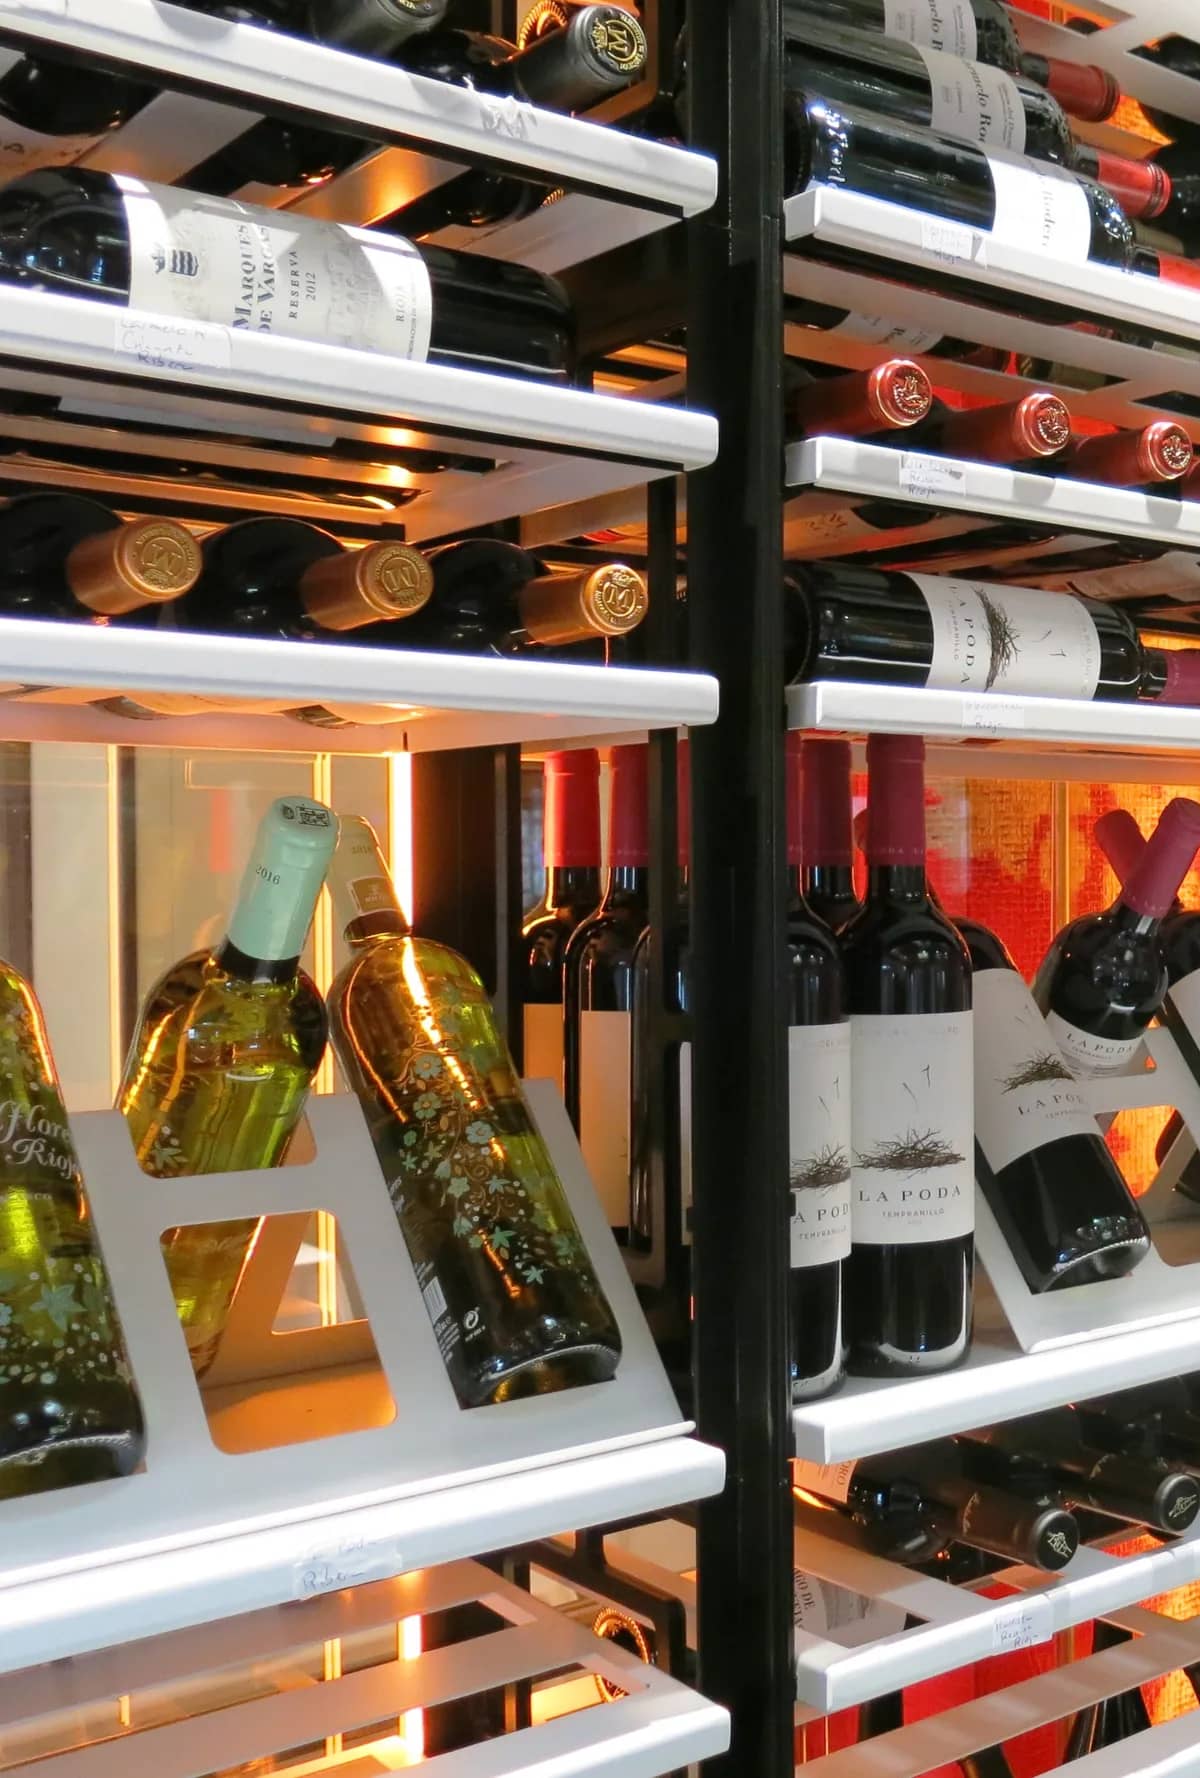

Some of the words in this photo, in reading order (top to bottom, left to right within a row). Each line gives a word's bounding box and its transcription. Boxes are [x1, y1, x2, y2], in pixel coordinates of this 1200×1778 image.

[288, 250, 299, 320] RESERVA
[305, 271, 317, 301] 2012
[395, 284, 405, 322] RIOJA
[960, 617, 977, 684] PODA
[255, 863, 281, 886] 2016
[1017, 1098, 1046, 1116] LA
[859, 1189, 889, 1202] LA
[901, 1184, 961, 1202] PODA
[817, 1202, 849, 1221] POD
[881, 1207, 945, 1219] TEMPRANILLO
